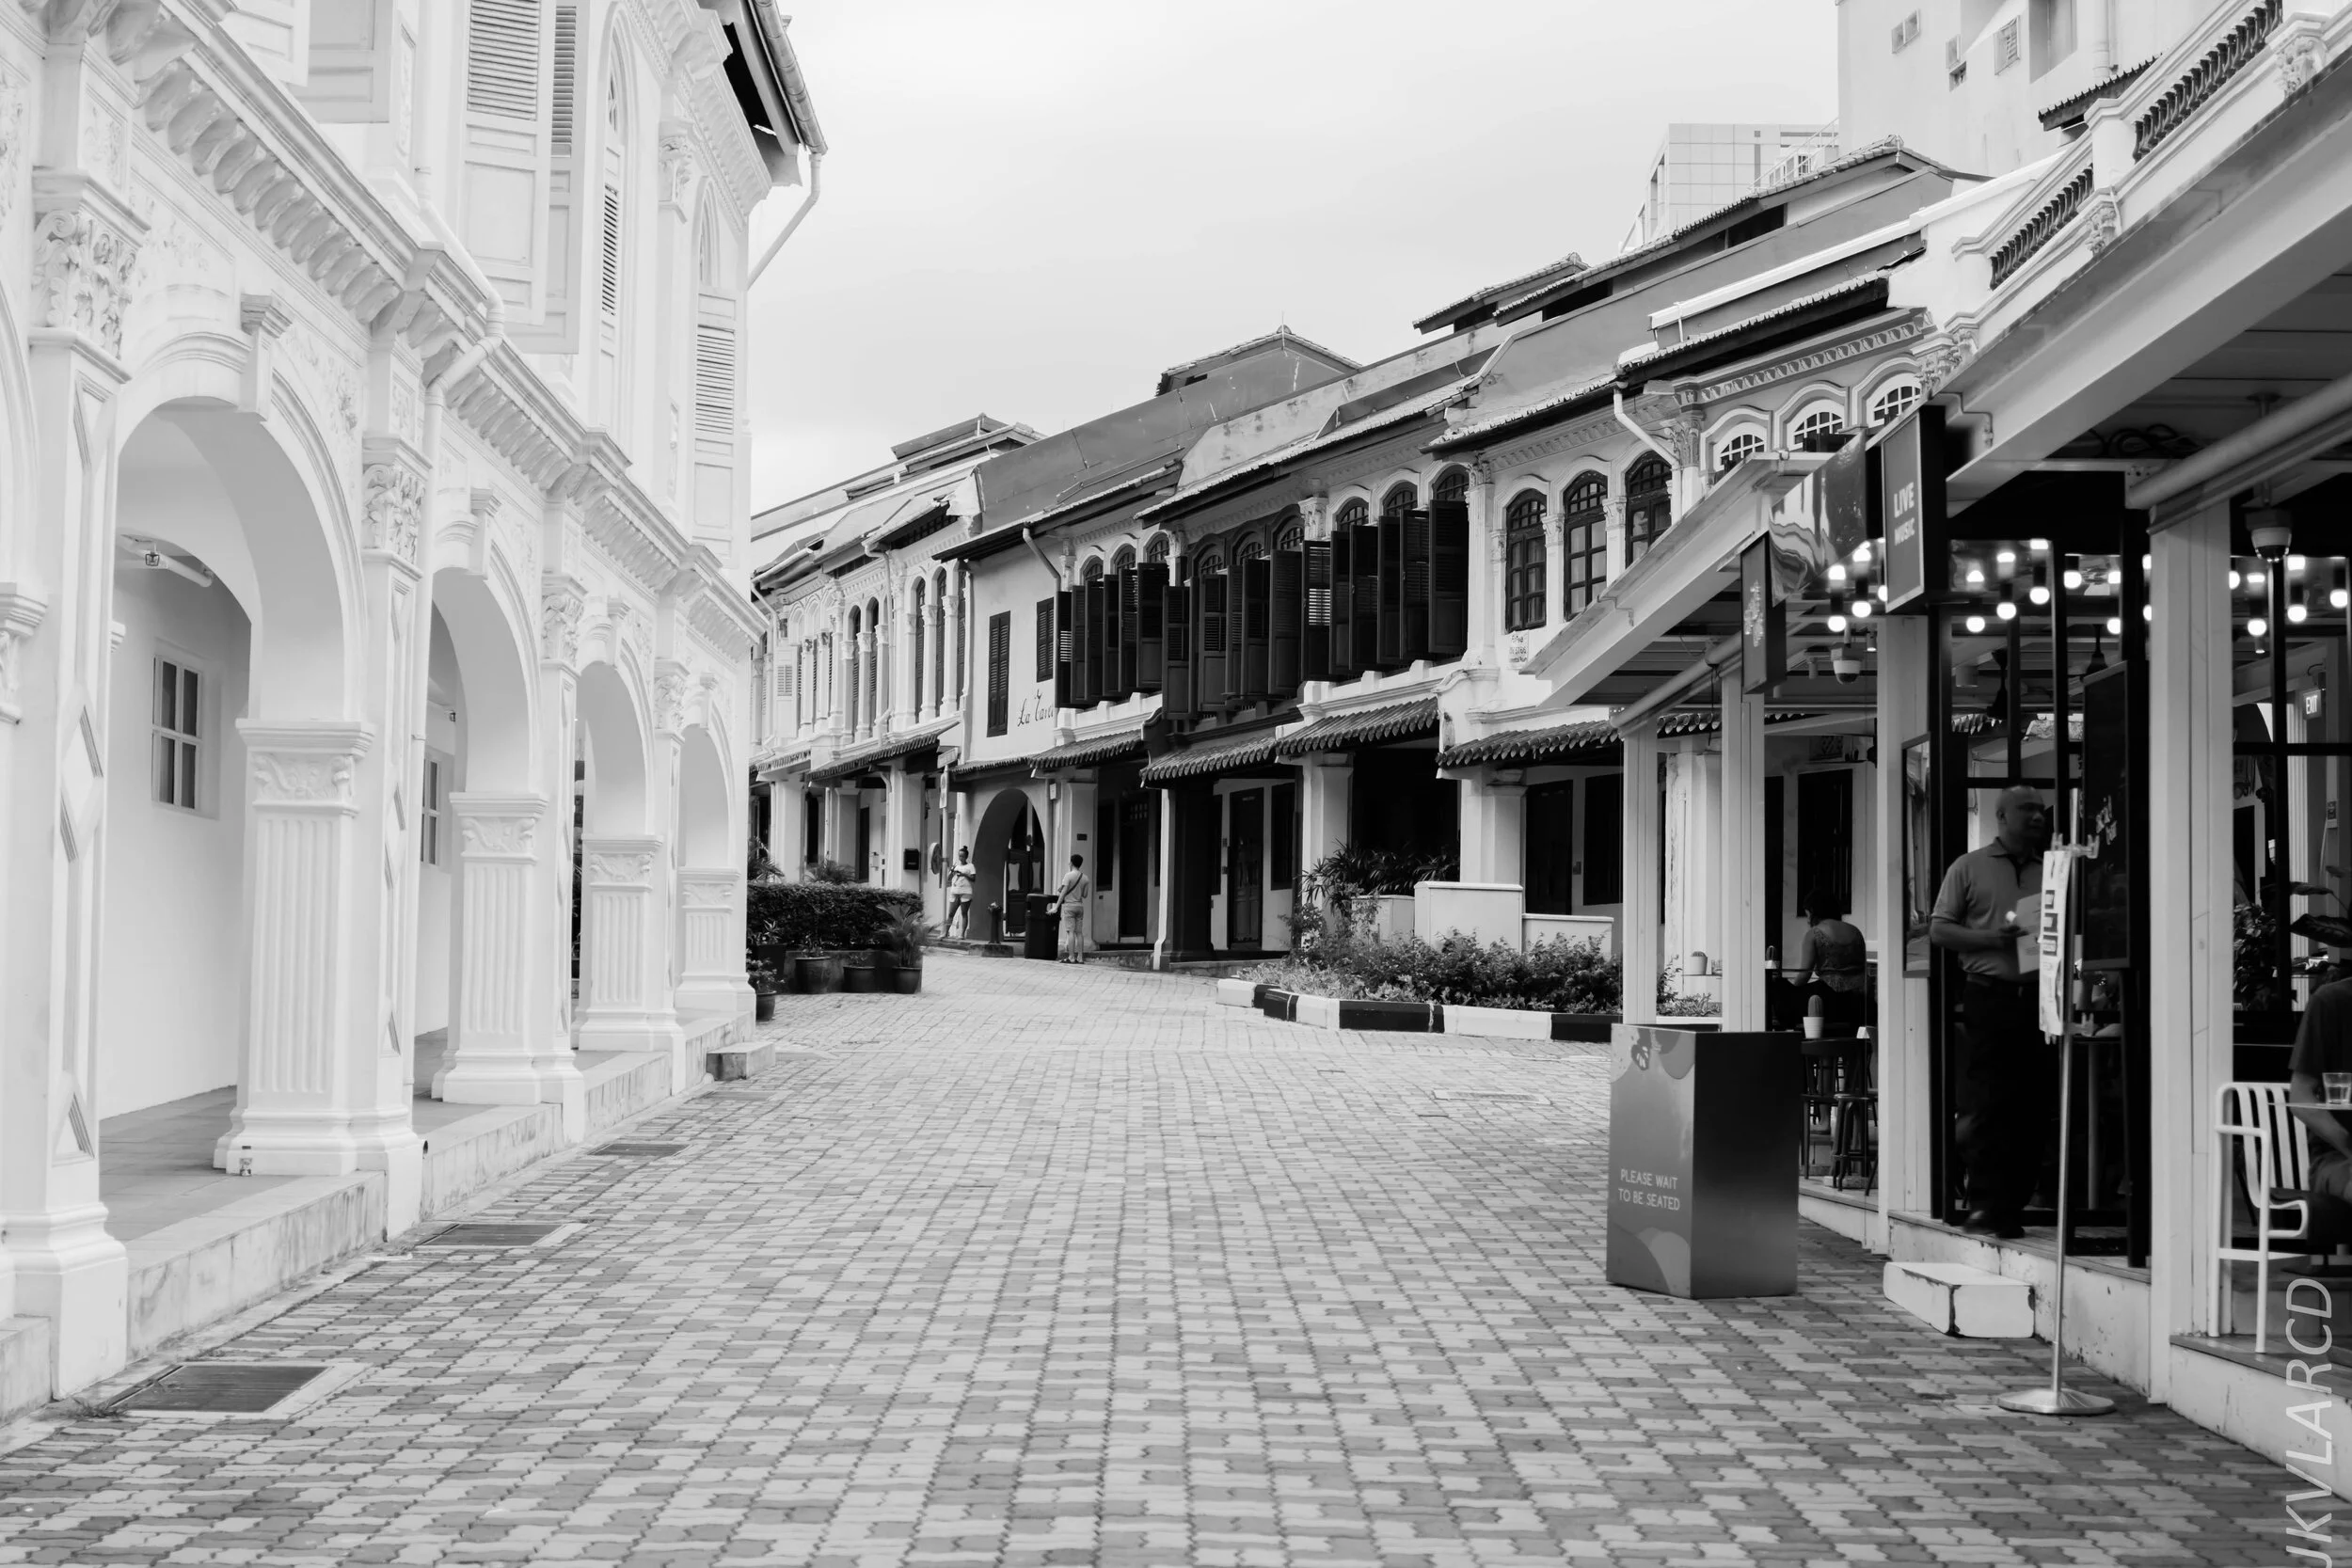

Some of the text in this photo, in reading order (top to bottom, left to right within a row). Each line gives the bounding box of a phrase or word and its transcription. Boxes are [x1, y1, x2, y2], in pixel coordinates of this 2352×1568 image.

[1894, 482, 1915, 518] LIVE
[1895, 517, 1915, 546] MUSIC
[1621, 1168, 1678, 1190] PLEASE WAIT
[1618, 1188, 1680, 1211] TO BE SEATED
